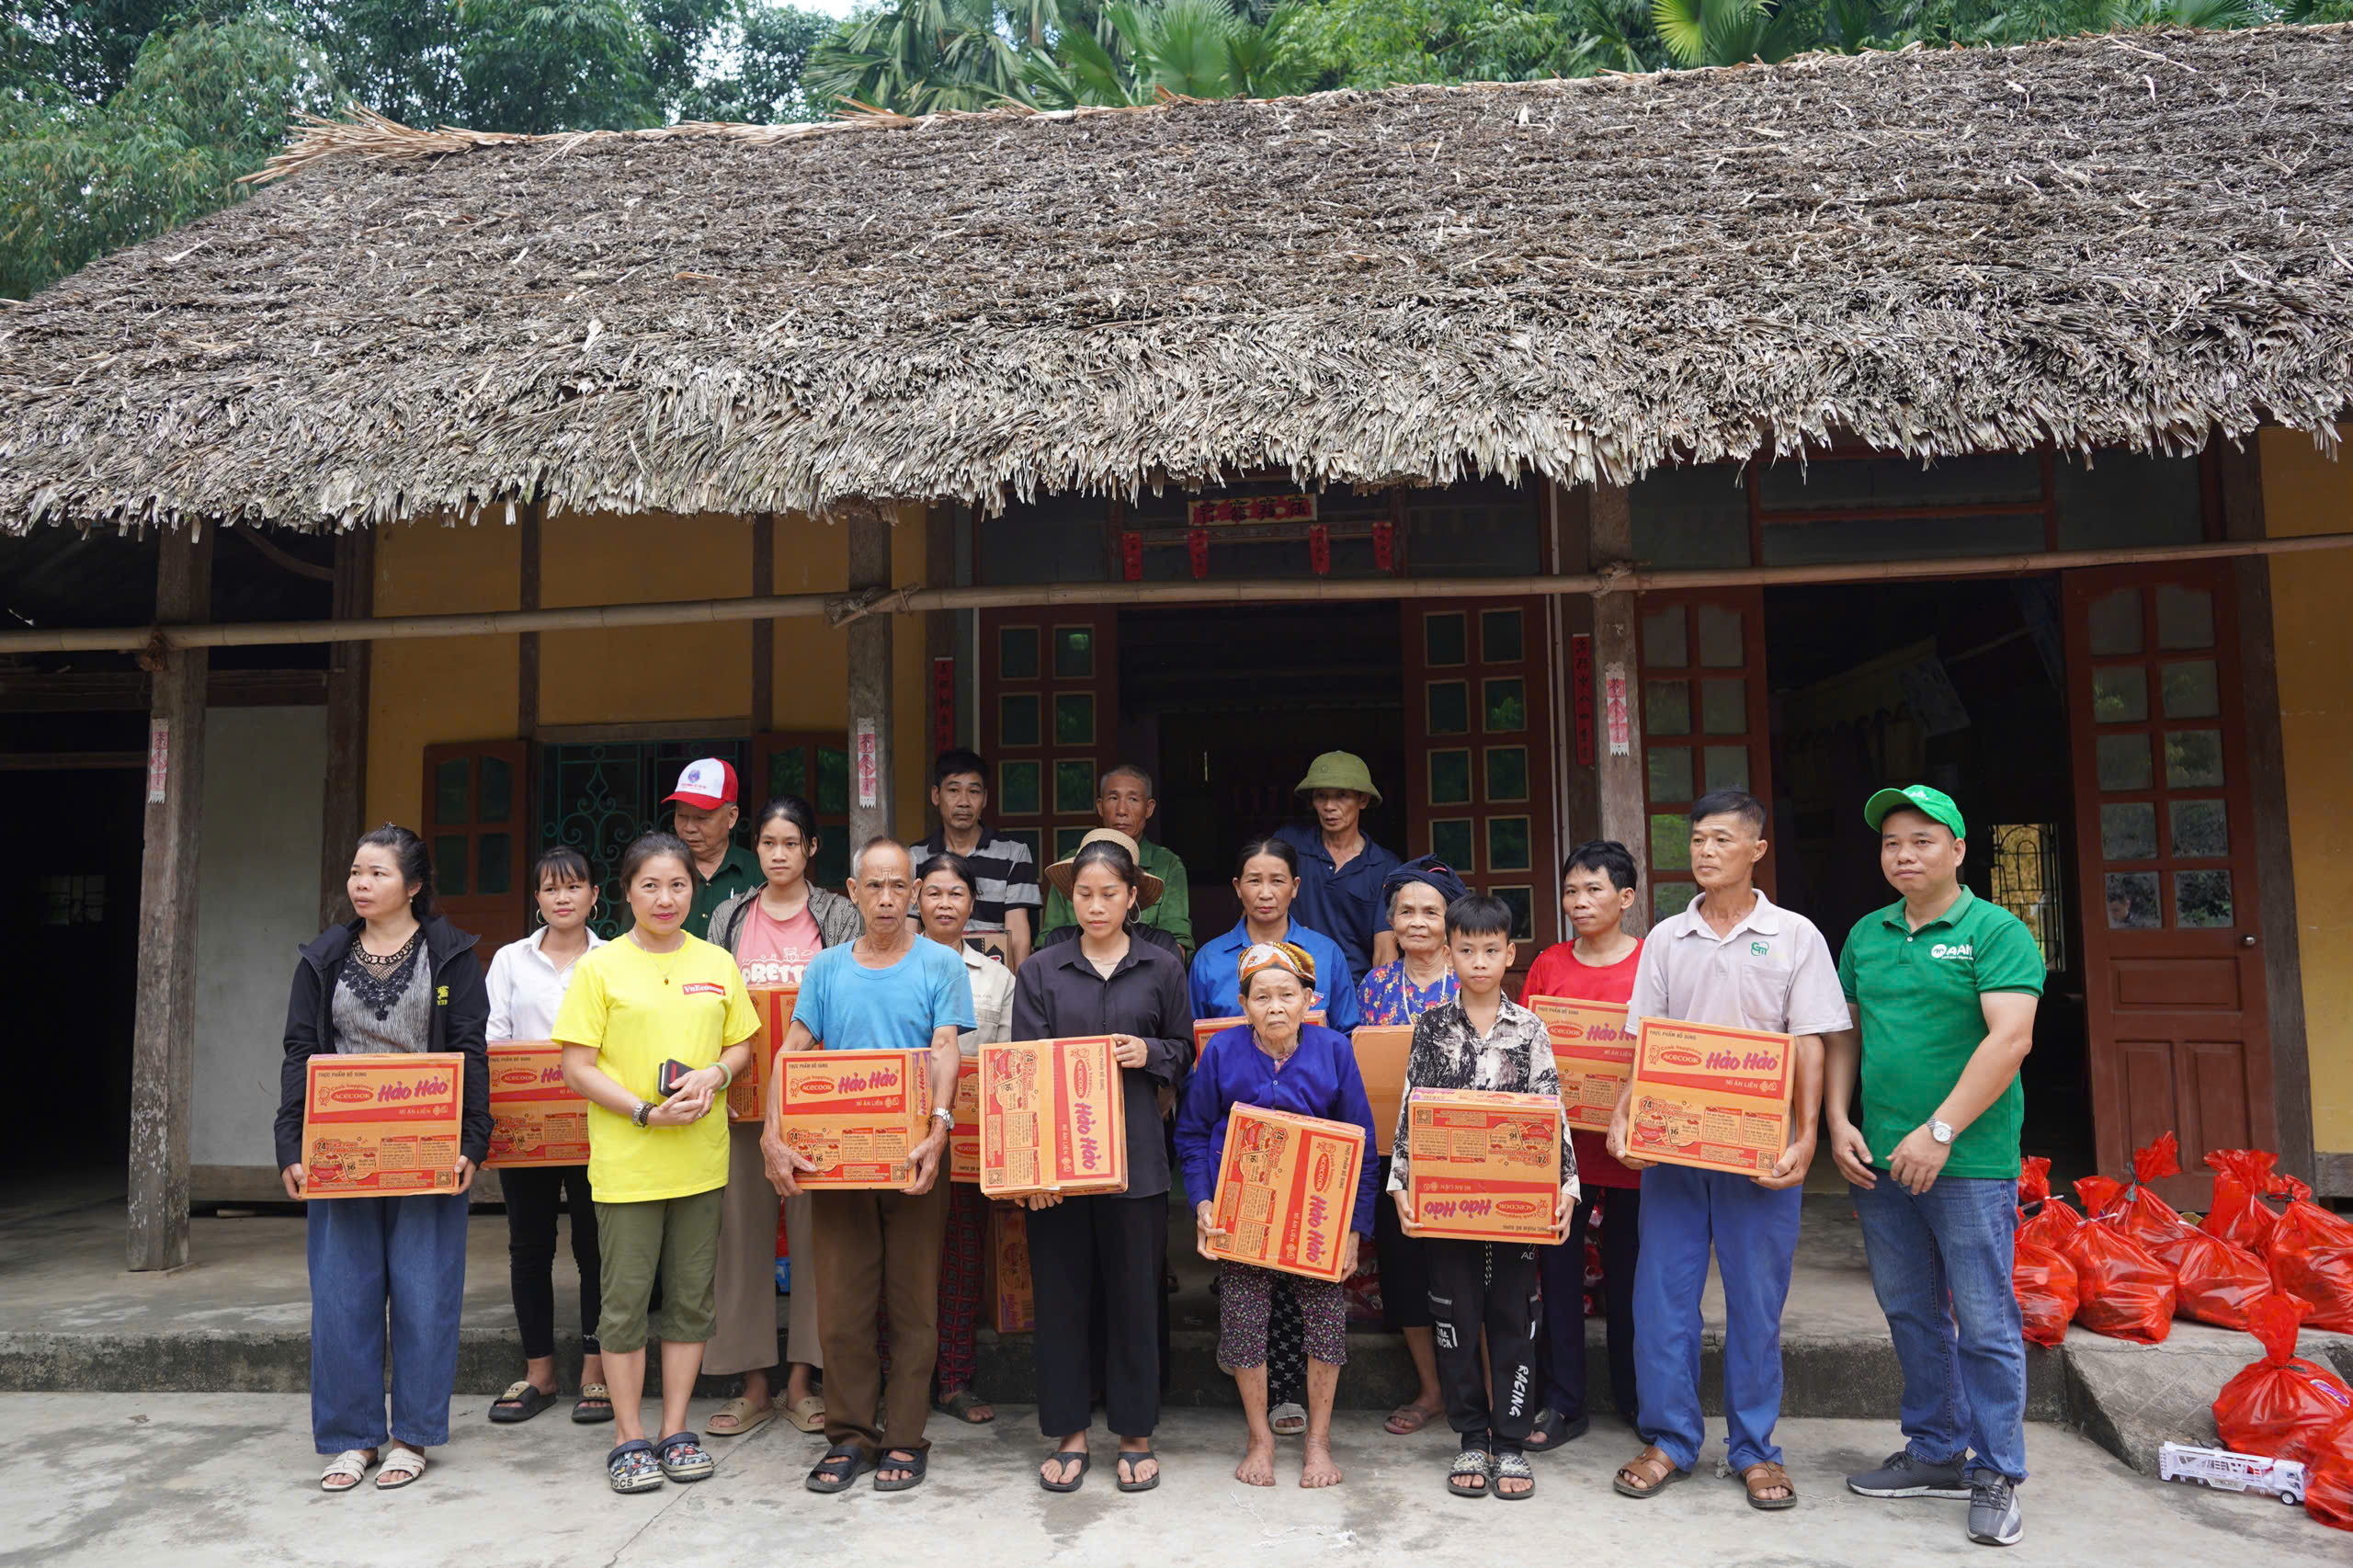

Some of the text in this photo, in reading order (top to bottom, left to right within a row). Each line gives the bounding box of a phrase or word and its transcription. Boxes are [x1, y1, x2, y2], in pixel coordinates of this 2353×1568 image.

[684, 984, 723, 995] VnEconomy
[1586, 1023, 1617, 1041] Hảo
[1025, 1052, 1034, 1062] 24
[1705, 1049, 1778, 1072] Hảo Hảo
[540, 1065, 563, 1084] Hả
[838, 1067, 898, 1094] Hảo Hảo
[377, 1076, 449, 1103] Hảo Hảo
[1643, 1099, 1652, 1108] 24
[790, 1131, 798, 1142] 24
[1074, 1103, 1102, 1170] Hảo Hảo
[1276, 1131, 1285, 1141] 24
[316, 1142, 326, 1151] 24
[1425, 1199, 1492, 1221] Hảo Hảo
[1305, 1195, 1328, 1263] Hảo Hảo
[1508, 1364, 1529, 1418] RACING
